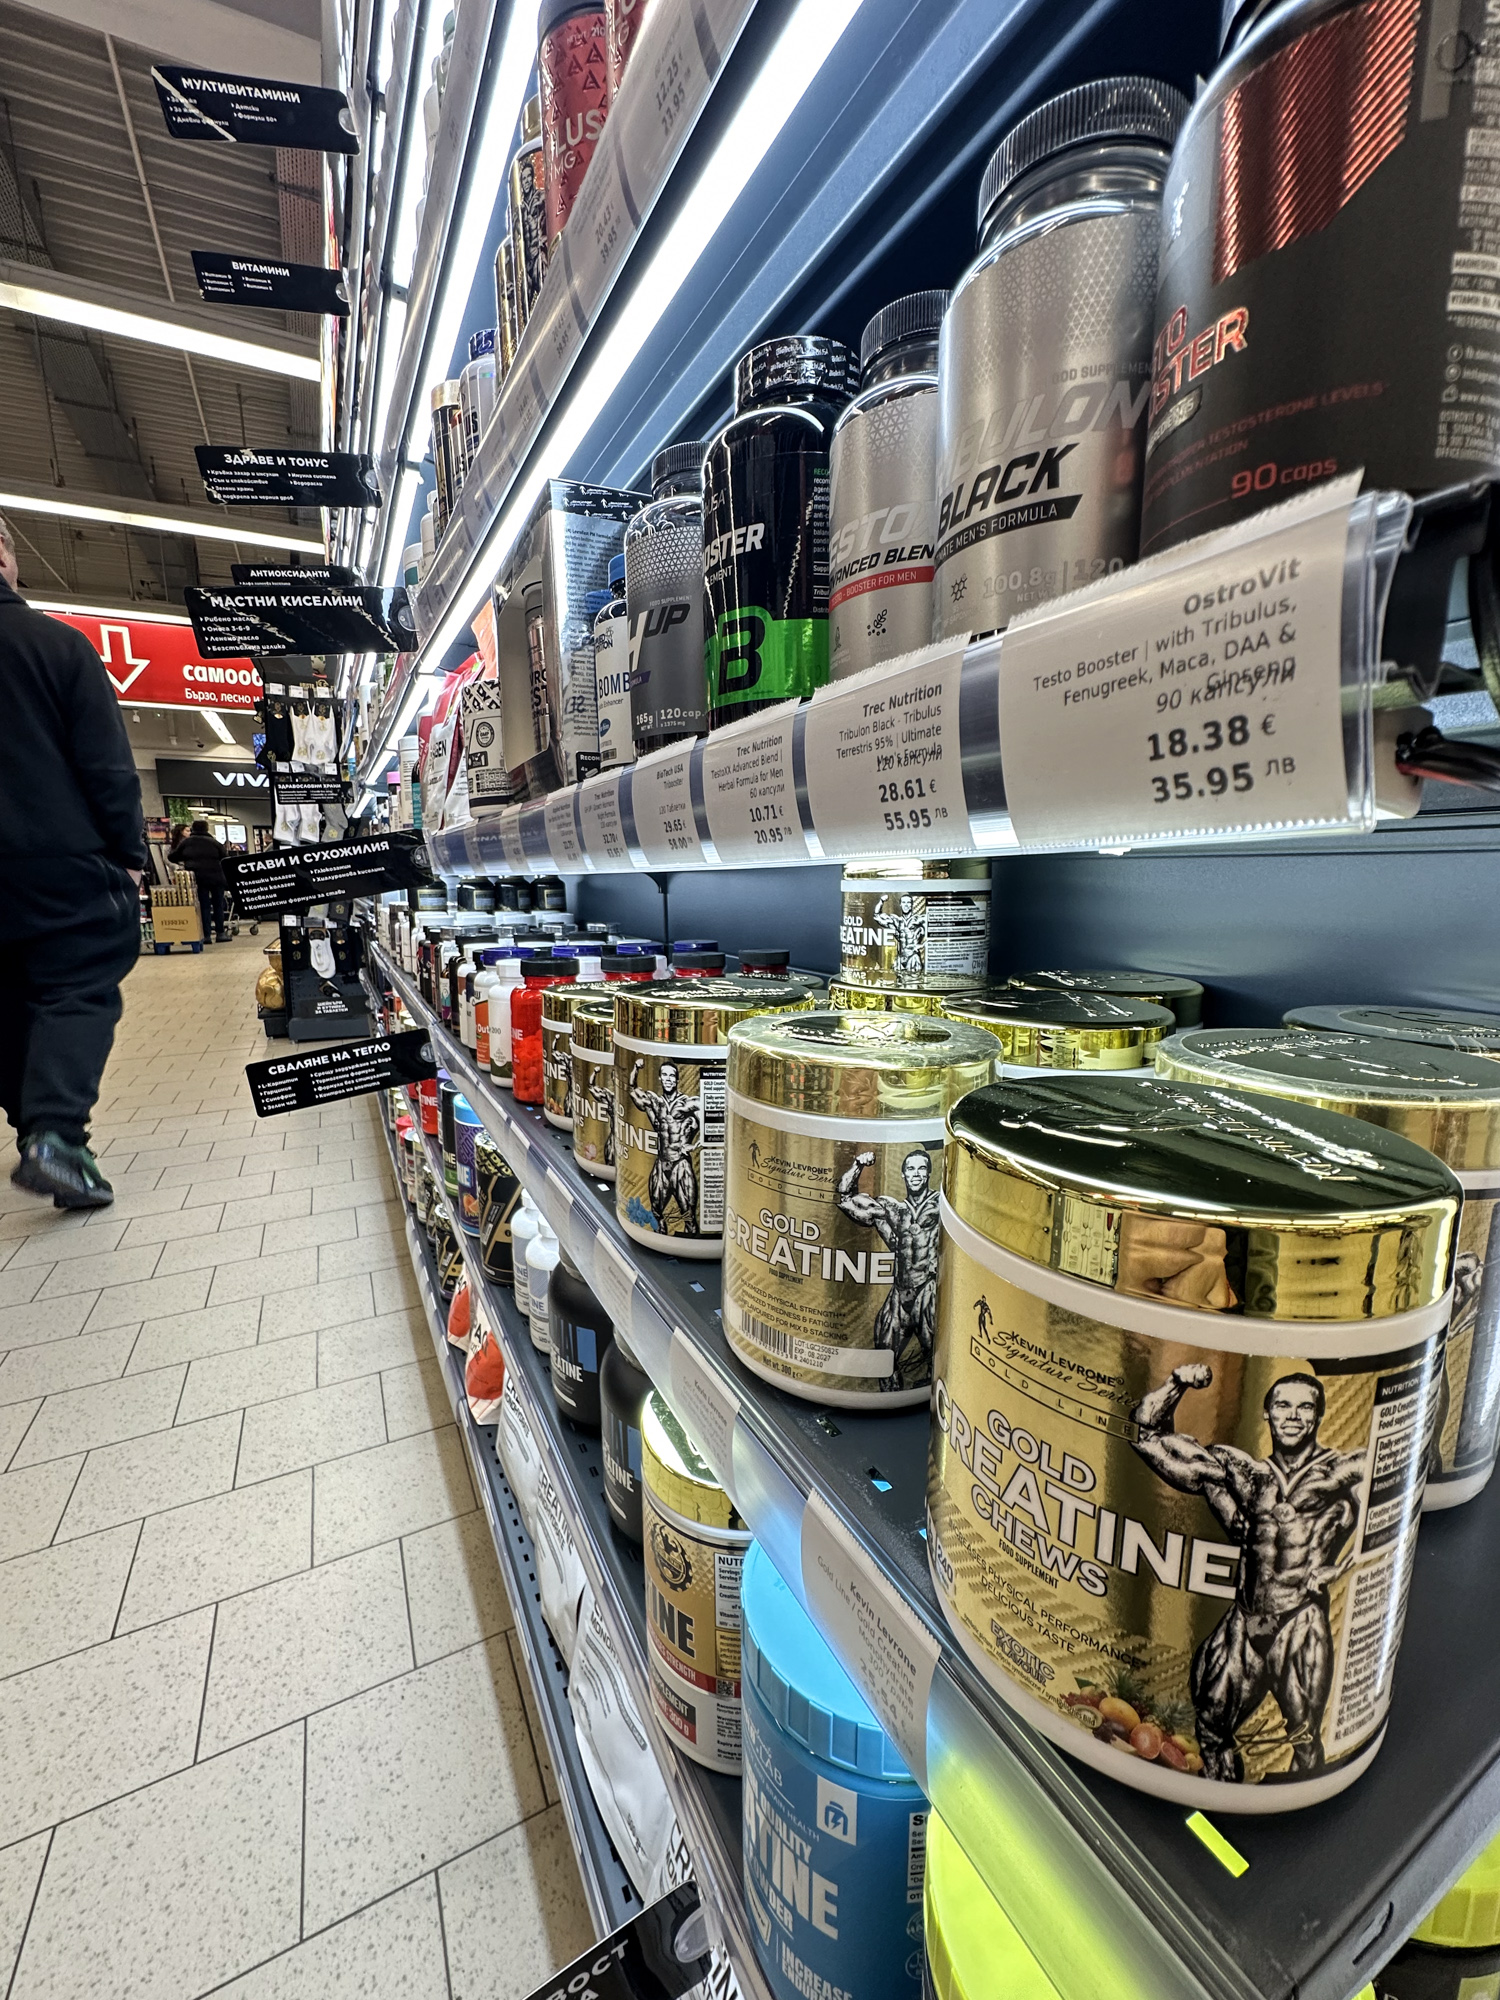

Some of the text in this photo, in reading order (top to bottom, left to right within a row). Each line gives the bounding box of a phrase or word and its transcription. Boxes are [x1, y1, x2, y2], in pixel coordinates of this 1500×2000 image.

[181, 77, 301, 103] МУЛТИВИТАМИНИ
[231, 261, 290, 277] ВИТАМИНИ
[223, 453, 329, 468] ЗДРАВЕ И ТОНУС
[937, 442, 1081, 541] BLACK
[1231, 458, 1338, 498] 90 caps
[989, 504, 1060, 534] FORMULA
[249, 570, 330, 578] АНТИОКСИДАНТИ
[846, 571, 917, 597] BOOSTER FOR MEN
[1183, 557, 1301, 616] OstroVit
[209, 595, 363, 607] МАСТНИ КИСЕЛИНИ
[1032, 597, 1298, 692] Testo Booster with Tribulus,
[1063, 621, 1297, 707] Fenugreek, Maca, DAA &
[184, 688, 218, 702] Бързо,
[220, 693, 251, 703] лесно
[603, 698, 623, 708] Enhancer
[863, 684, 943, 718] Trec Nutrition
[1155, 689, 1182, 714] 90
[660, 708, 682, 720] 120
[838, 704, 942, 742] Tribulon Black Tribulus
[736, 735, 783, 758] Trec Nutrition
[836, 724, 943, 760] Terrestris 95% Ultimate
[1146, 713, 1277, 762] 18.38 €
[673, 763, 684, 775] USA
[732, 752, 779, 773] Advanced Blend
[718, 768, 784, 792] Herbal Formula for Men
[749, 783, 786, 799] 60 капсули
[878, 777, 937, 803] 28.61 €
[1150, 757, 1297, 804] 35.95 лв
[663, 819, 684, 834] 29.65
[749, 804, 778, 823] 10.71
[883, 807, 949, 831] 55.95 лв
[668, 837, 689, 851] 58.00
[754, 827, 784, 845] 20.95
[237, 841, 390, 873] СТАВИ И СУХОЖИЛИЯ
[268, 1042, 391, 1075] СВАЛЯНЕ НА ТЕГЛО
[769, 1155, 791, 1169] KEVIN
[759, 1208, 821, 1242] GOLD
[726, 1205, 897, 1286] CREATINE
[766, 1292, 800, 1311] PHYSICAL
[766, 1302, 802, 1322] TIREDNESS
[775, 1318, 791, 1330] FOR
[790, 1323, 803, 1334] MIX
[809, 1329, 849, 1342] STACKING
[992, 1330, 1074, 1384] Signature
[1010, 1331, 1048, 1361] KEVIN
[973, 1345, 1030, 1390] GOLD
[1379, 1416, 1394, 1431] Food
[1380, 1404, 1397, 1418] GOLD
[987, 1408, 1097, 1493] GOLD
[935, 1378, 1243, 1602] CREATINE
[970, 1483, 1109, 1597] CHEWS
[998, 1538, 1060, 1590] FOOD SUPPLEMENT
[817, 1555, 915, 1691] Gold Line Gold Creatine
[849, 1580, 917, 1677] Kevin Levrone
[980, 1574, 1076, 1655] DELICIOUS TASTE
[987, 1563, 1039, 1614] PHYSICAL
[1040, 1608, 1143, 1668] PERFORMANCE
[990, 1618, 1056, 1682] EXOTIC
[663, 1652, 697, 1682] STRENGTH
[858, 1624, 915, 1709] Monohydrate
[788, 1808, 820, 1842] HEALTH
